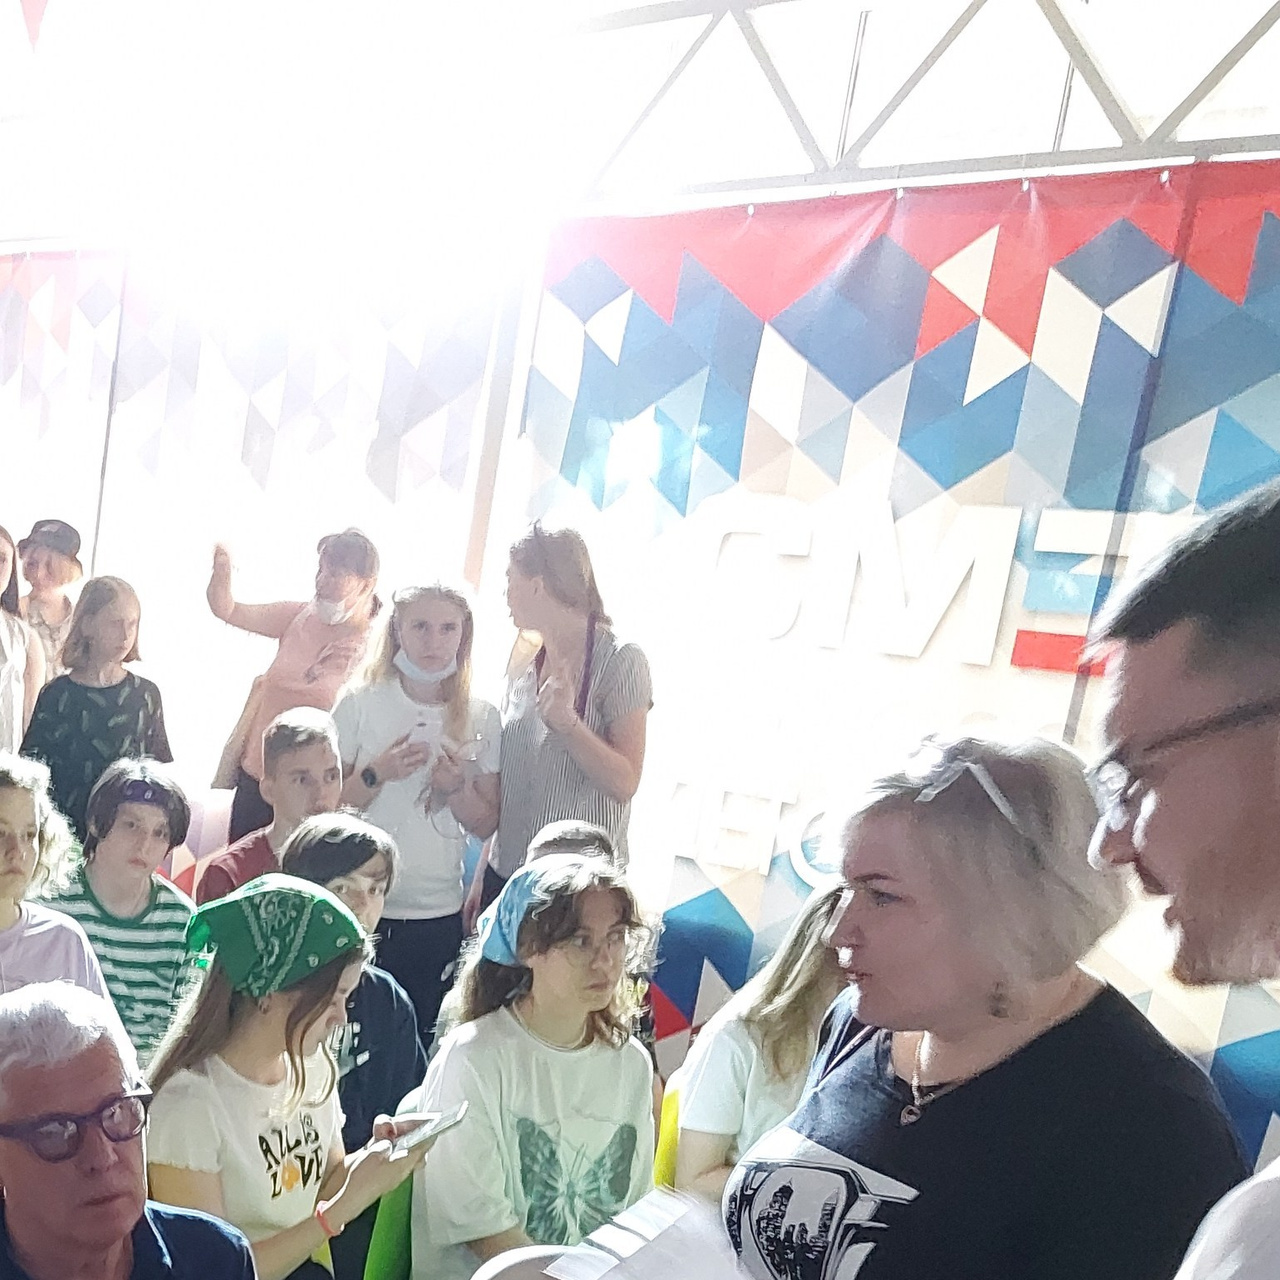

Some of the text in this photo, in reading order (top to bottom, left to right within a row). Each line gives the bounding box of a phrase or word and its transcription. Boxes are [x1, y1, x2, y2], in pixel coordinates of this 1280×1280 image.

[680, 488, 1137, 677] СМЕ
[258, 1110, 320, 1172] ALL IS
